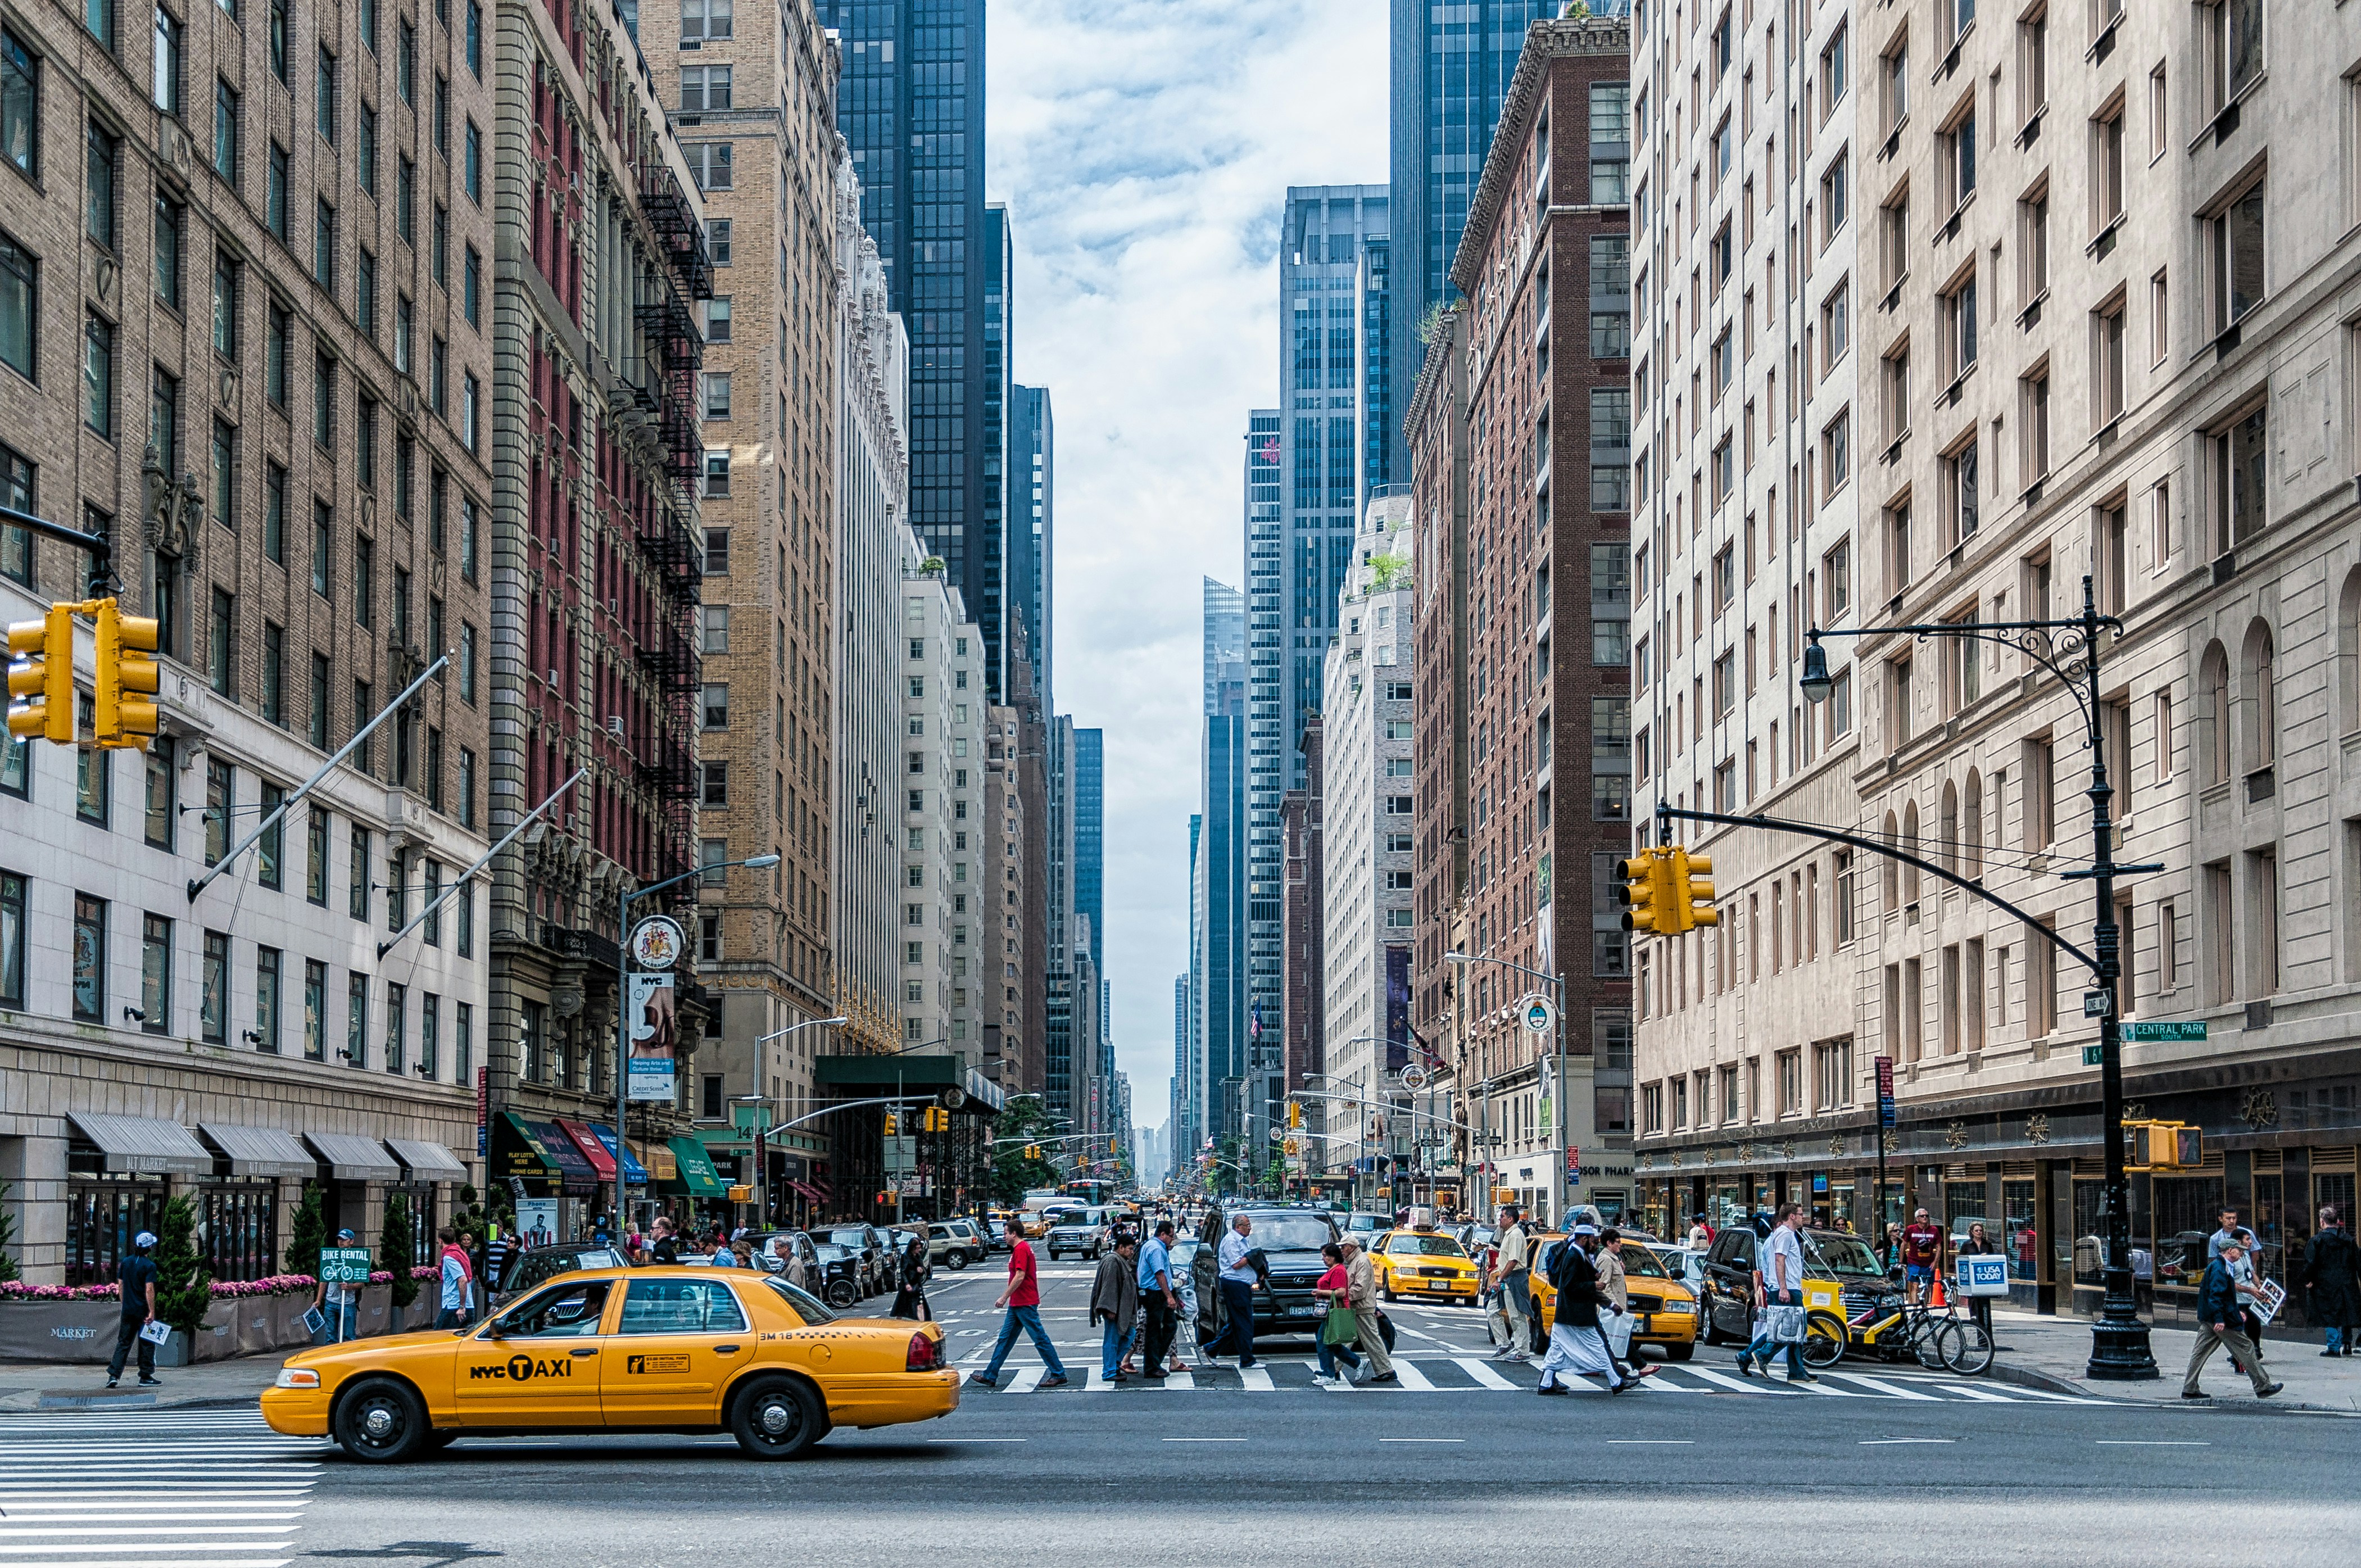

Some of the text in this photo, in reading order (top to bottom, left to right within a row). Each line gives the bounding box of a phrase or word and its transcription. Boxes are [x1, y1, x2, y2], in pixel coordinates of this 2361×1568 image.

[2088, 999, 2097, 1010] ONE
[2136, 1023, 2205, 1035] CENTRAL PARK
[2092, 1051, 2097, 1062] 6
[126, 1156, 167, 1171] BLT MARKET
[249, 1162, 257, 1173] BLT
[259, 1163, 280, 1174] MARKET
[322, 1250, 369, 1261] BIKE RENTAL
[51, 1327, 96, 1338] MARKET
[470, 1359, 572, 1379] NYC TAXI
